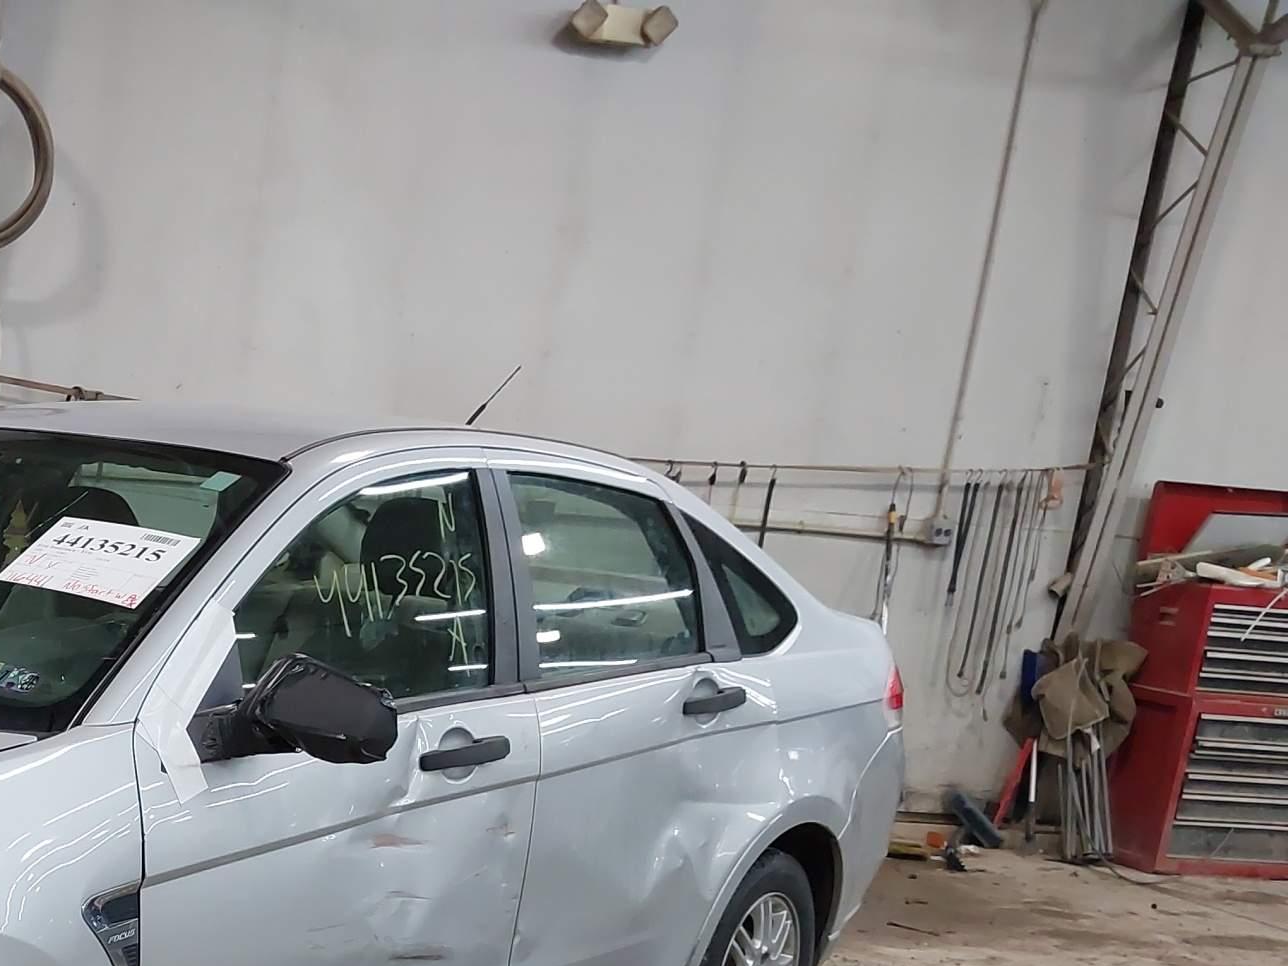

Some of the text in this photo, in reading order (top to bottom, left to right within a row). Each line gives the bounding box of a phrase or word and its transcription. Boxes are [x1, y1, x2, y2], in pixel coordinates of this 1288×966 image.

[53, 533, 167, 561] 44135215
[313, 550, 477, 638] 44135215
[108, 928, 136, 944] FOCUS
